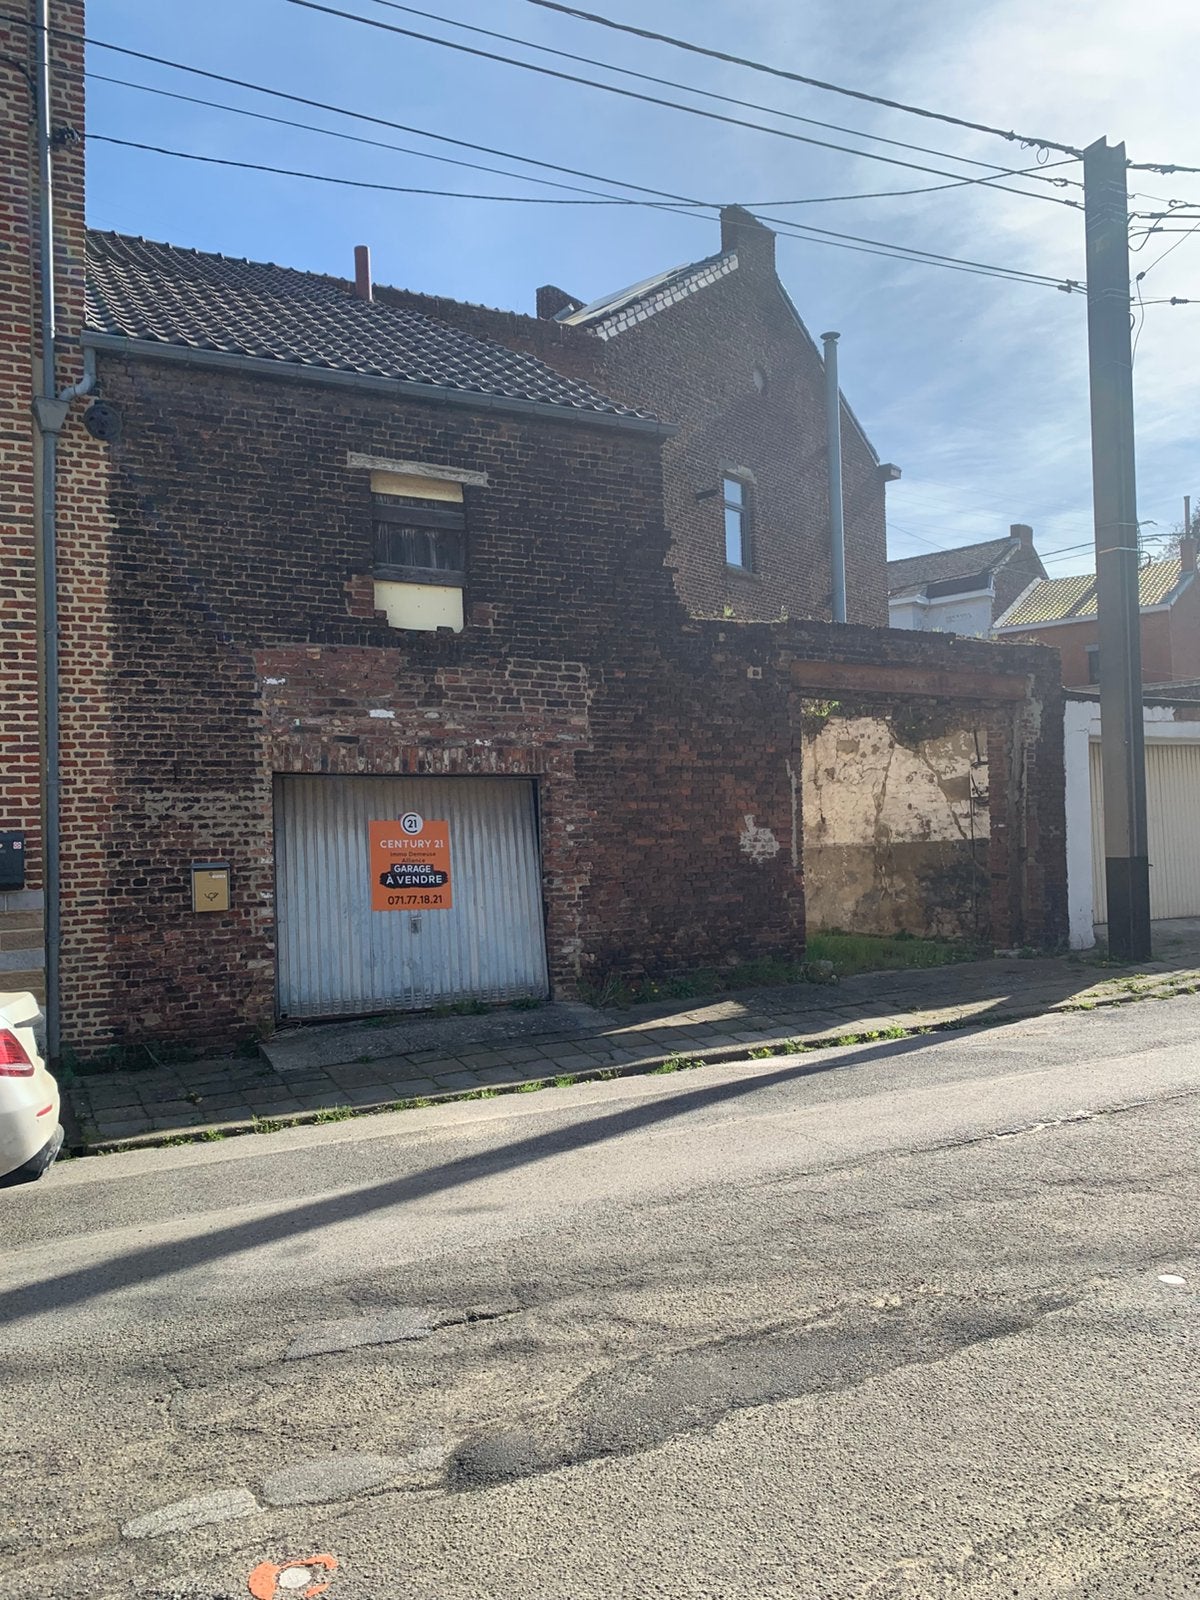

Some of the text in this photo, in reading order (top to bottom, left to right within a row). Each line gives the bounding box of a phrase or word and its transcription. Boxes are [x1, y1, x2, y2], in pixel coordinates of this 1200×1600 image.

[407, 819, 417, 829] 21
[379, 839, 444, 849] CENTURY 21
[393, 864, 431, 873] GARAGE
[386, 873, 443, 885] À VENDRE
[387, 894, 443, 905] 071.77.18.21
